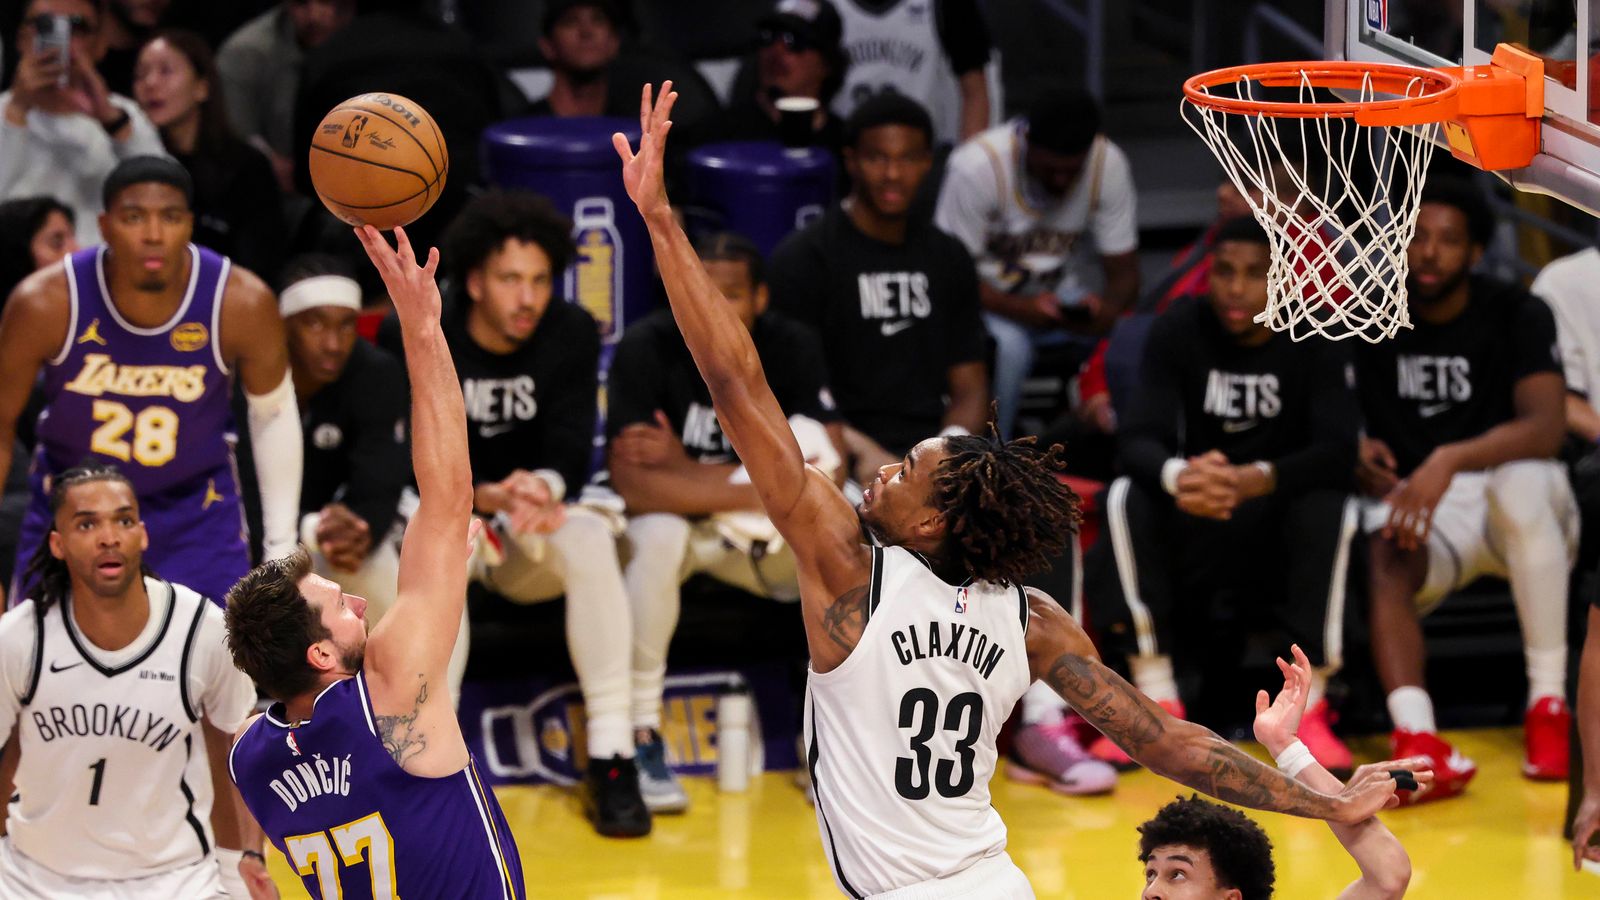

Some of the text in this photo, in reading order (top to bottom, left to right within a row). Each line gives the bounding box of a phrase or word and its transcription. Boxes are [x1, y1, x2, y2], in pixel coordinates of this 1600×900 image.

[859, 272, 931, 318] NETS
[65, 354, 207, 402] LAKERS
[464, 375, 537, 421] NETS
[1204, 369, 1281, 417] NETS
[1398, 355, 1471, 401] NETS
[91, 400, 179, 466] 28
[682, 402, 732, 450] NE
[892, 622, 1005, 680] CLAXTON
[33, 703, 181, 751] BROOKLYN
[895, 688, 983, 800] 33
[88, 758, 106, 806] 1
[269, 753, 352, 812] DONČIĆ
[284, 811, 401, 900] 77
